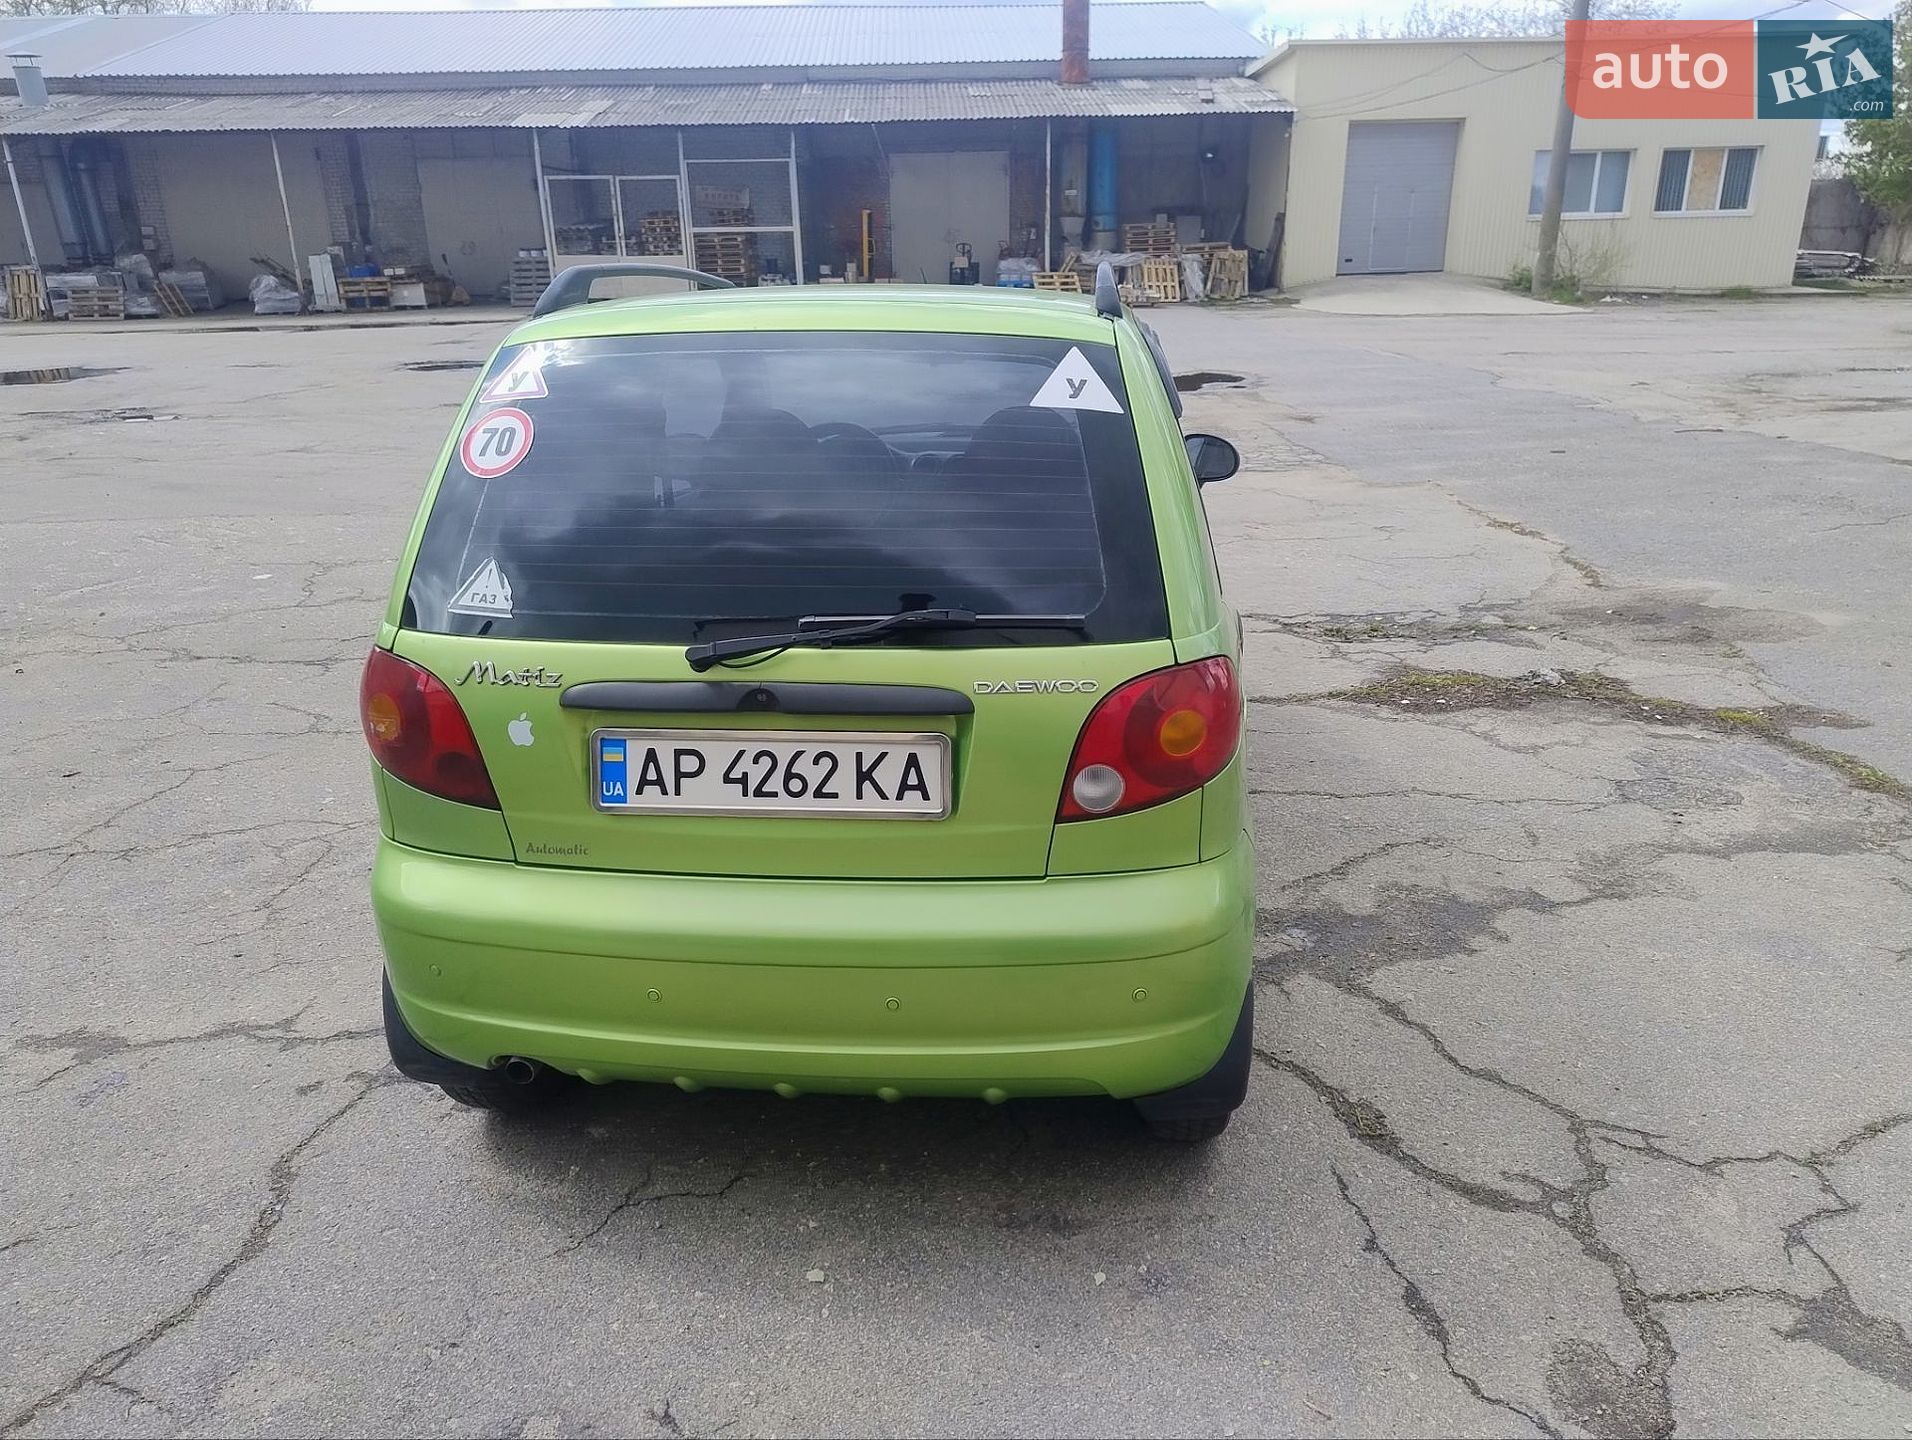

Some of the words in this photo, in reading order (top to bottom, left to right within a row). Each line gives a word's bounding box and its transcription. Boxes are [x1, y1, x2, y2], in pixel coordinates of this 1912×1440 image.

[478, 426, 517, 458] 70
[470, 592, 498, 605] ГАЗ
[454, 660, 564, 688] Matiz
[973, 679, 1100, 695] DAEWOO
[634, 747, 707, 797] AP
[722, 749, 840, 799] 4262
[854, 750, 931, 802] KA
[602, 781, 625, 797] UA
[525, 841, 590, 857] Automatic
